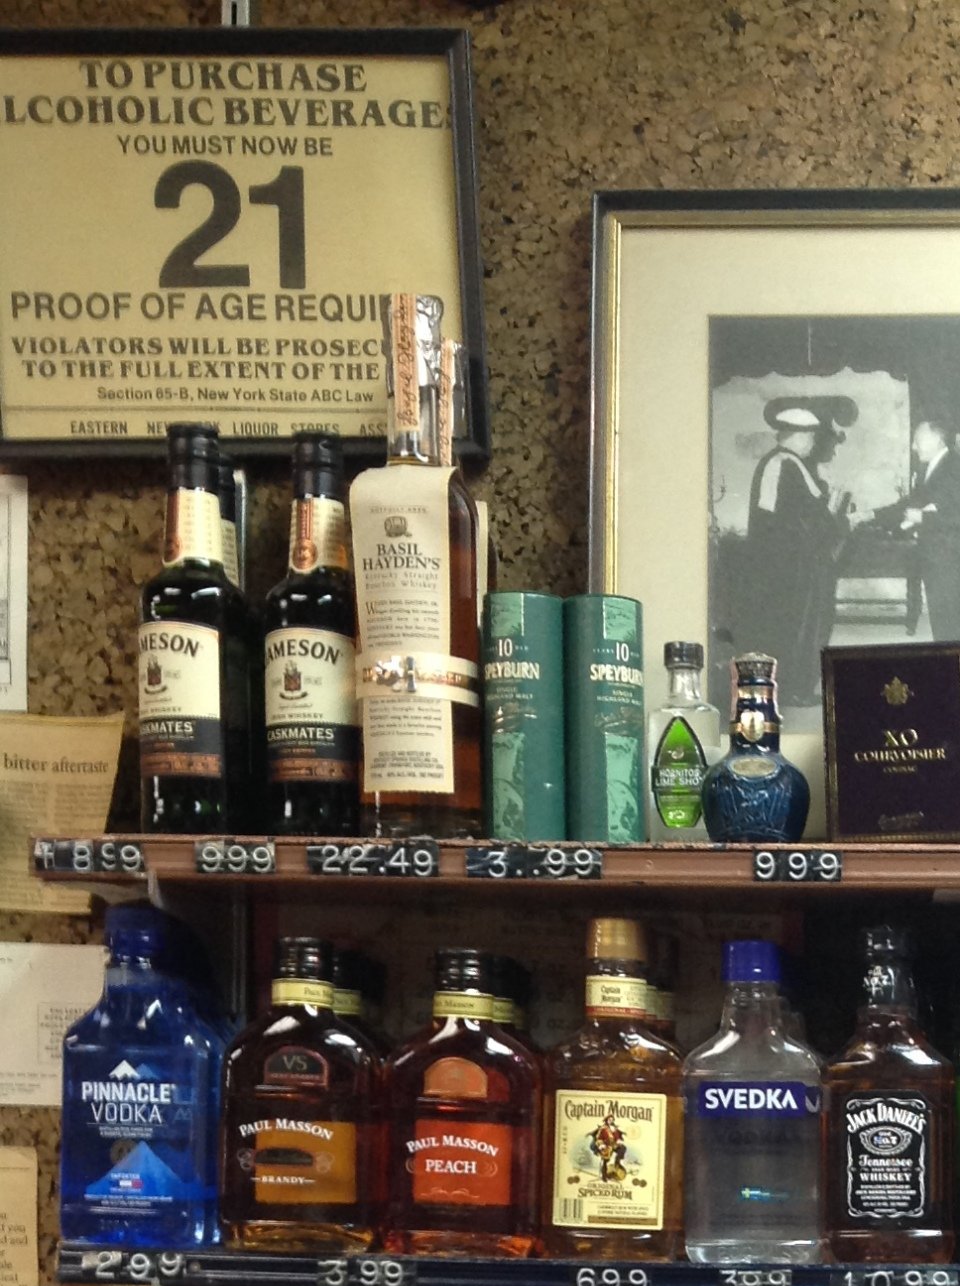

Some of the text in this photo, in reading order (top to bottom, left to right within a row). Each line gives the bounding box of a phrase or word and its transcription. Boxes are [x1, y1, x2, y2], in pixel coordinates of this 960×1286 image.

[79, 60, 367, 92] TO PURCHASE
[1, 95, 214, 126] LCOHOLIC
[118, 135, 333, 156] YOU MUST NOW BE
[153, 159, 306, 289] 21
[11, 292, 390, 322] PROOF OF AGE REQUI
[11, 337, 389, 357] VIOLATORS WILL BE PROSEC
[21, 360, 380, 380] TO THE FULL EXTENT OF THE
[97, 387, 152, 400] Section
[197, 388, 228, 400] New
[232, 388, 266, 401] York
[269, 388, 307, 401] State
[311, 388, 343, 401] ABC
[345, 389, 374, 402] Law
[70, 421, 279, 435] EASTERN LIQUOR
[376, 543, 423, 556] BASIL
[362, 557, 441, 571] HAYDEN'S
[499, 638, 513, 657] 10
[615, 642, 630, 662] 10
[884, 728, 919, 747] XO
[4, 753, 109, 773] bitter aftertaste
[655, 777, 678, 787] LIME
[282, 1055, 308, 1071] VS
[81, 1081, 172, 1103] PINNACLE
[704, 1088, 798, 1111] SVEDKA
[90, 1102, 163, 1124] VODKA
[564, 1099, 653, 1122] Captain Morgan
[846, 1102, 927, 1135] JACK DANIEL'S
[238, 1118, 334, 1141] PAUL MASSON
[405, 1135, 499, 1156] PAUL MASSON
[425, 1160, 478, 1174] PEACH
[859, 1172, 912, 1182] WHISKEY
[261, 1176, 305, 1184] BRANDY
[611, 1189, 633, 1200] RUM
